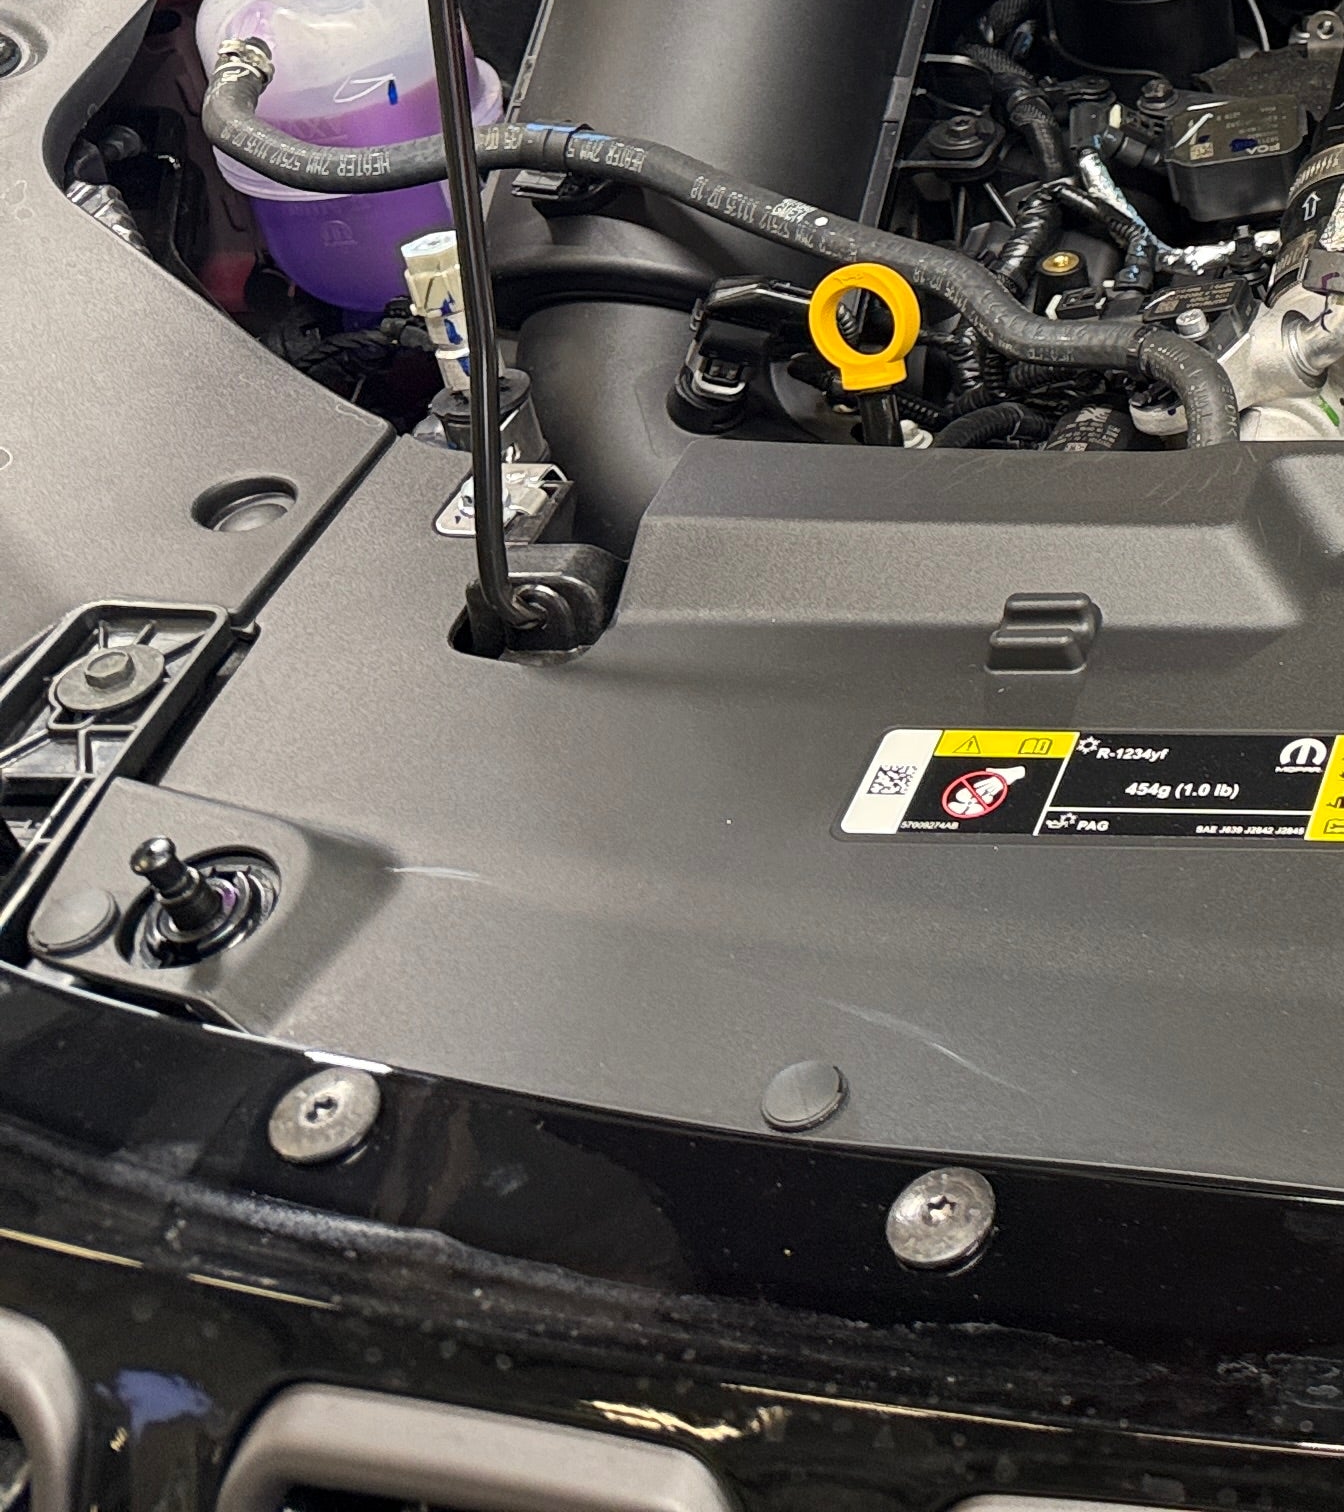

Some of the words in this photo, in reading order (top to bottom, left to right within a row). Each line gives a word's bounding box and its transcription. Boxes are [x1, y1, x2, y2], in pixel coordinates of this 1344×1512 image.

[337, 152, 391, 177] HEATER
[604, 141, 645, 174] HEATER
[1096, 747, 1169, 762] R-1234yf
[1275, 765, 1322, 774] MOPAR
[1125, 782, 1172, 799] 454g
[1175, 783, 1211, 799] (1.0
[1214, 783, 1240, 800] lb)
[1076, 820, 1110, 832] PAG
[1195, 825, 1219, 834] SAE
